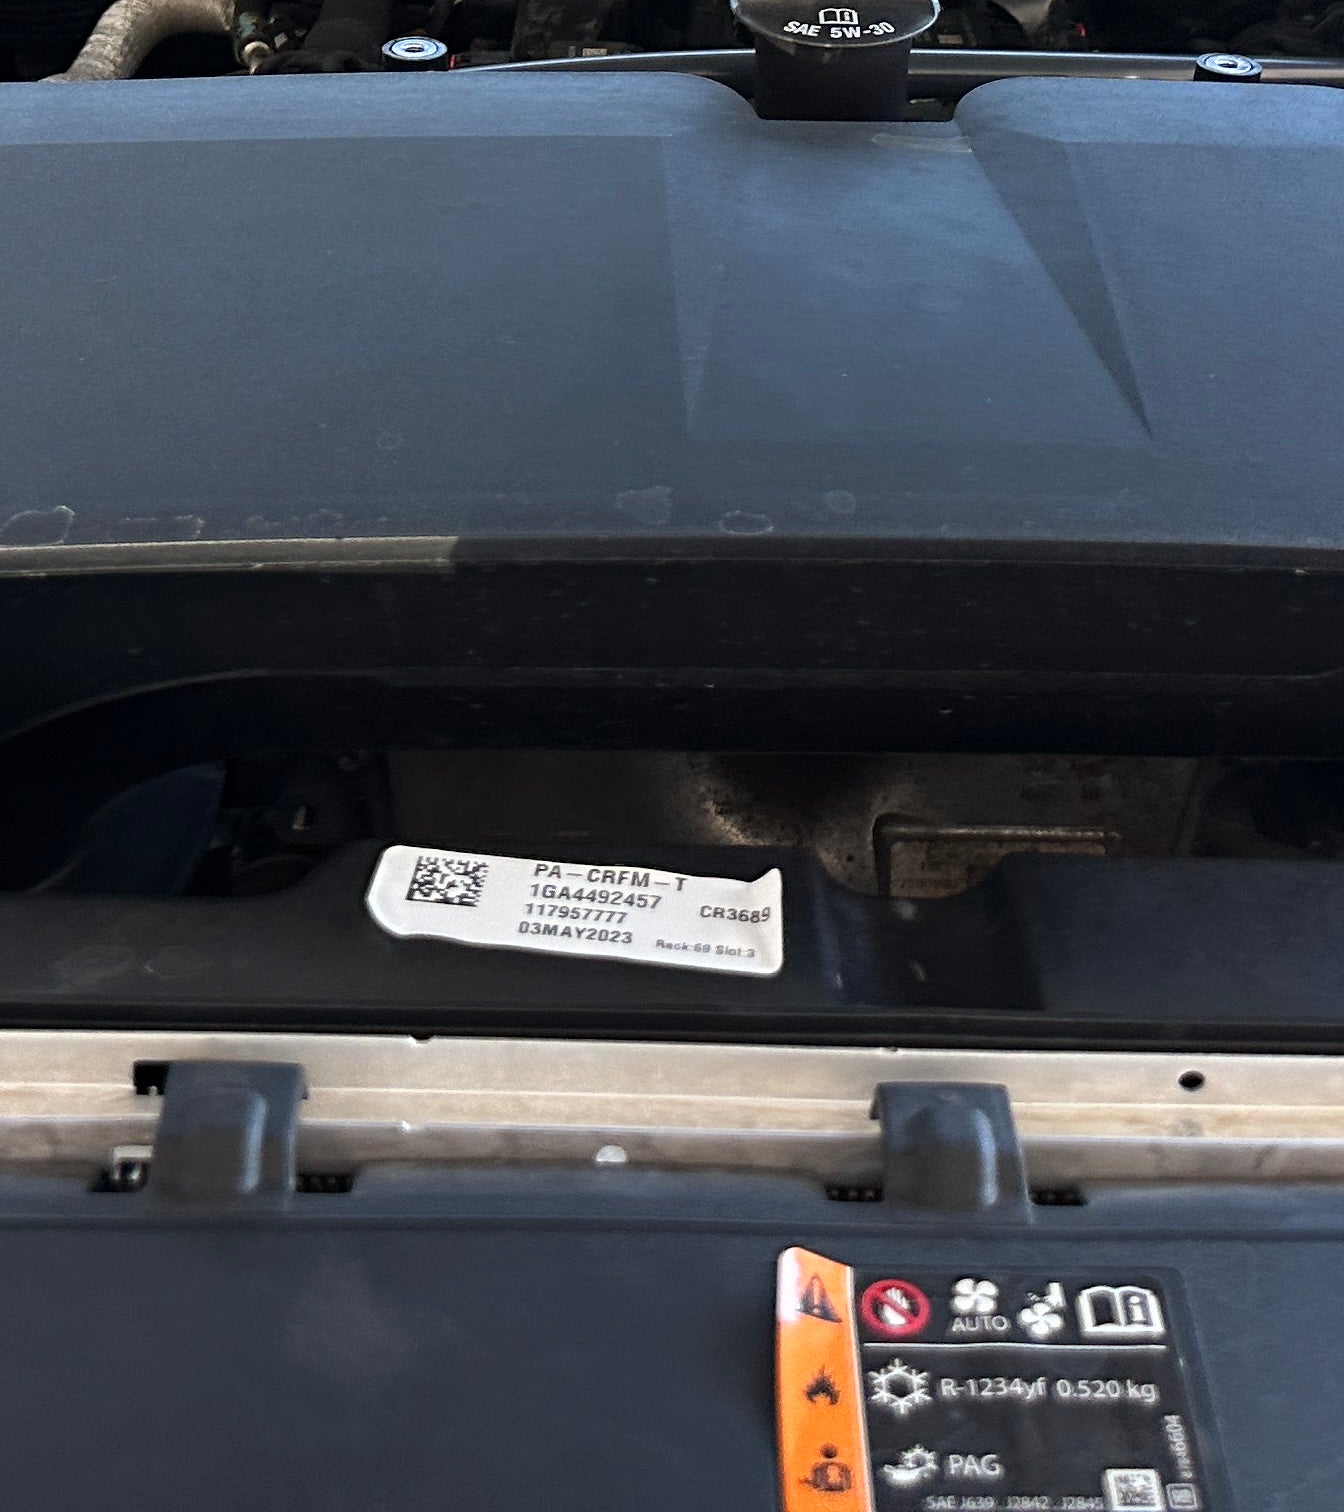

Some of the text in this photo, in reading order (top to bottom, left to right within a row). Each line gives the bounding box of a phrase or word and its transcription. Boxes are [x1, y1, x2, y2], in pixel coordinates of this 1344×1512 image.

[783, 21, 896, 39] SAE 5W-30
[530, 883, 663, 909] 1GA4492457
[524, 902, 628, 924] 117957777
[518, 920, 633, 944] 03MAY2023
[655, 938, 689, 951] Rack
[715, 944, 743, 958] Slot
[951, 1315, 1008, 1332] AUTO
[941, 1376, 1157, 1404] R-1234yf 0.520 kg
[949, 1453, 1002, 1476] PAG
[925, 1495, 956, 1510] SAE
